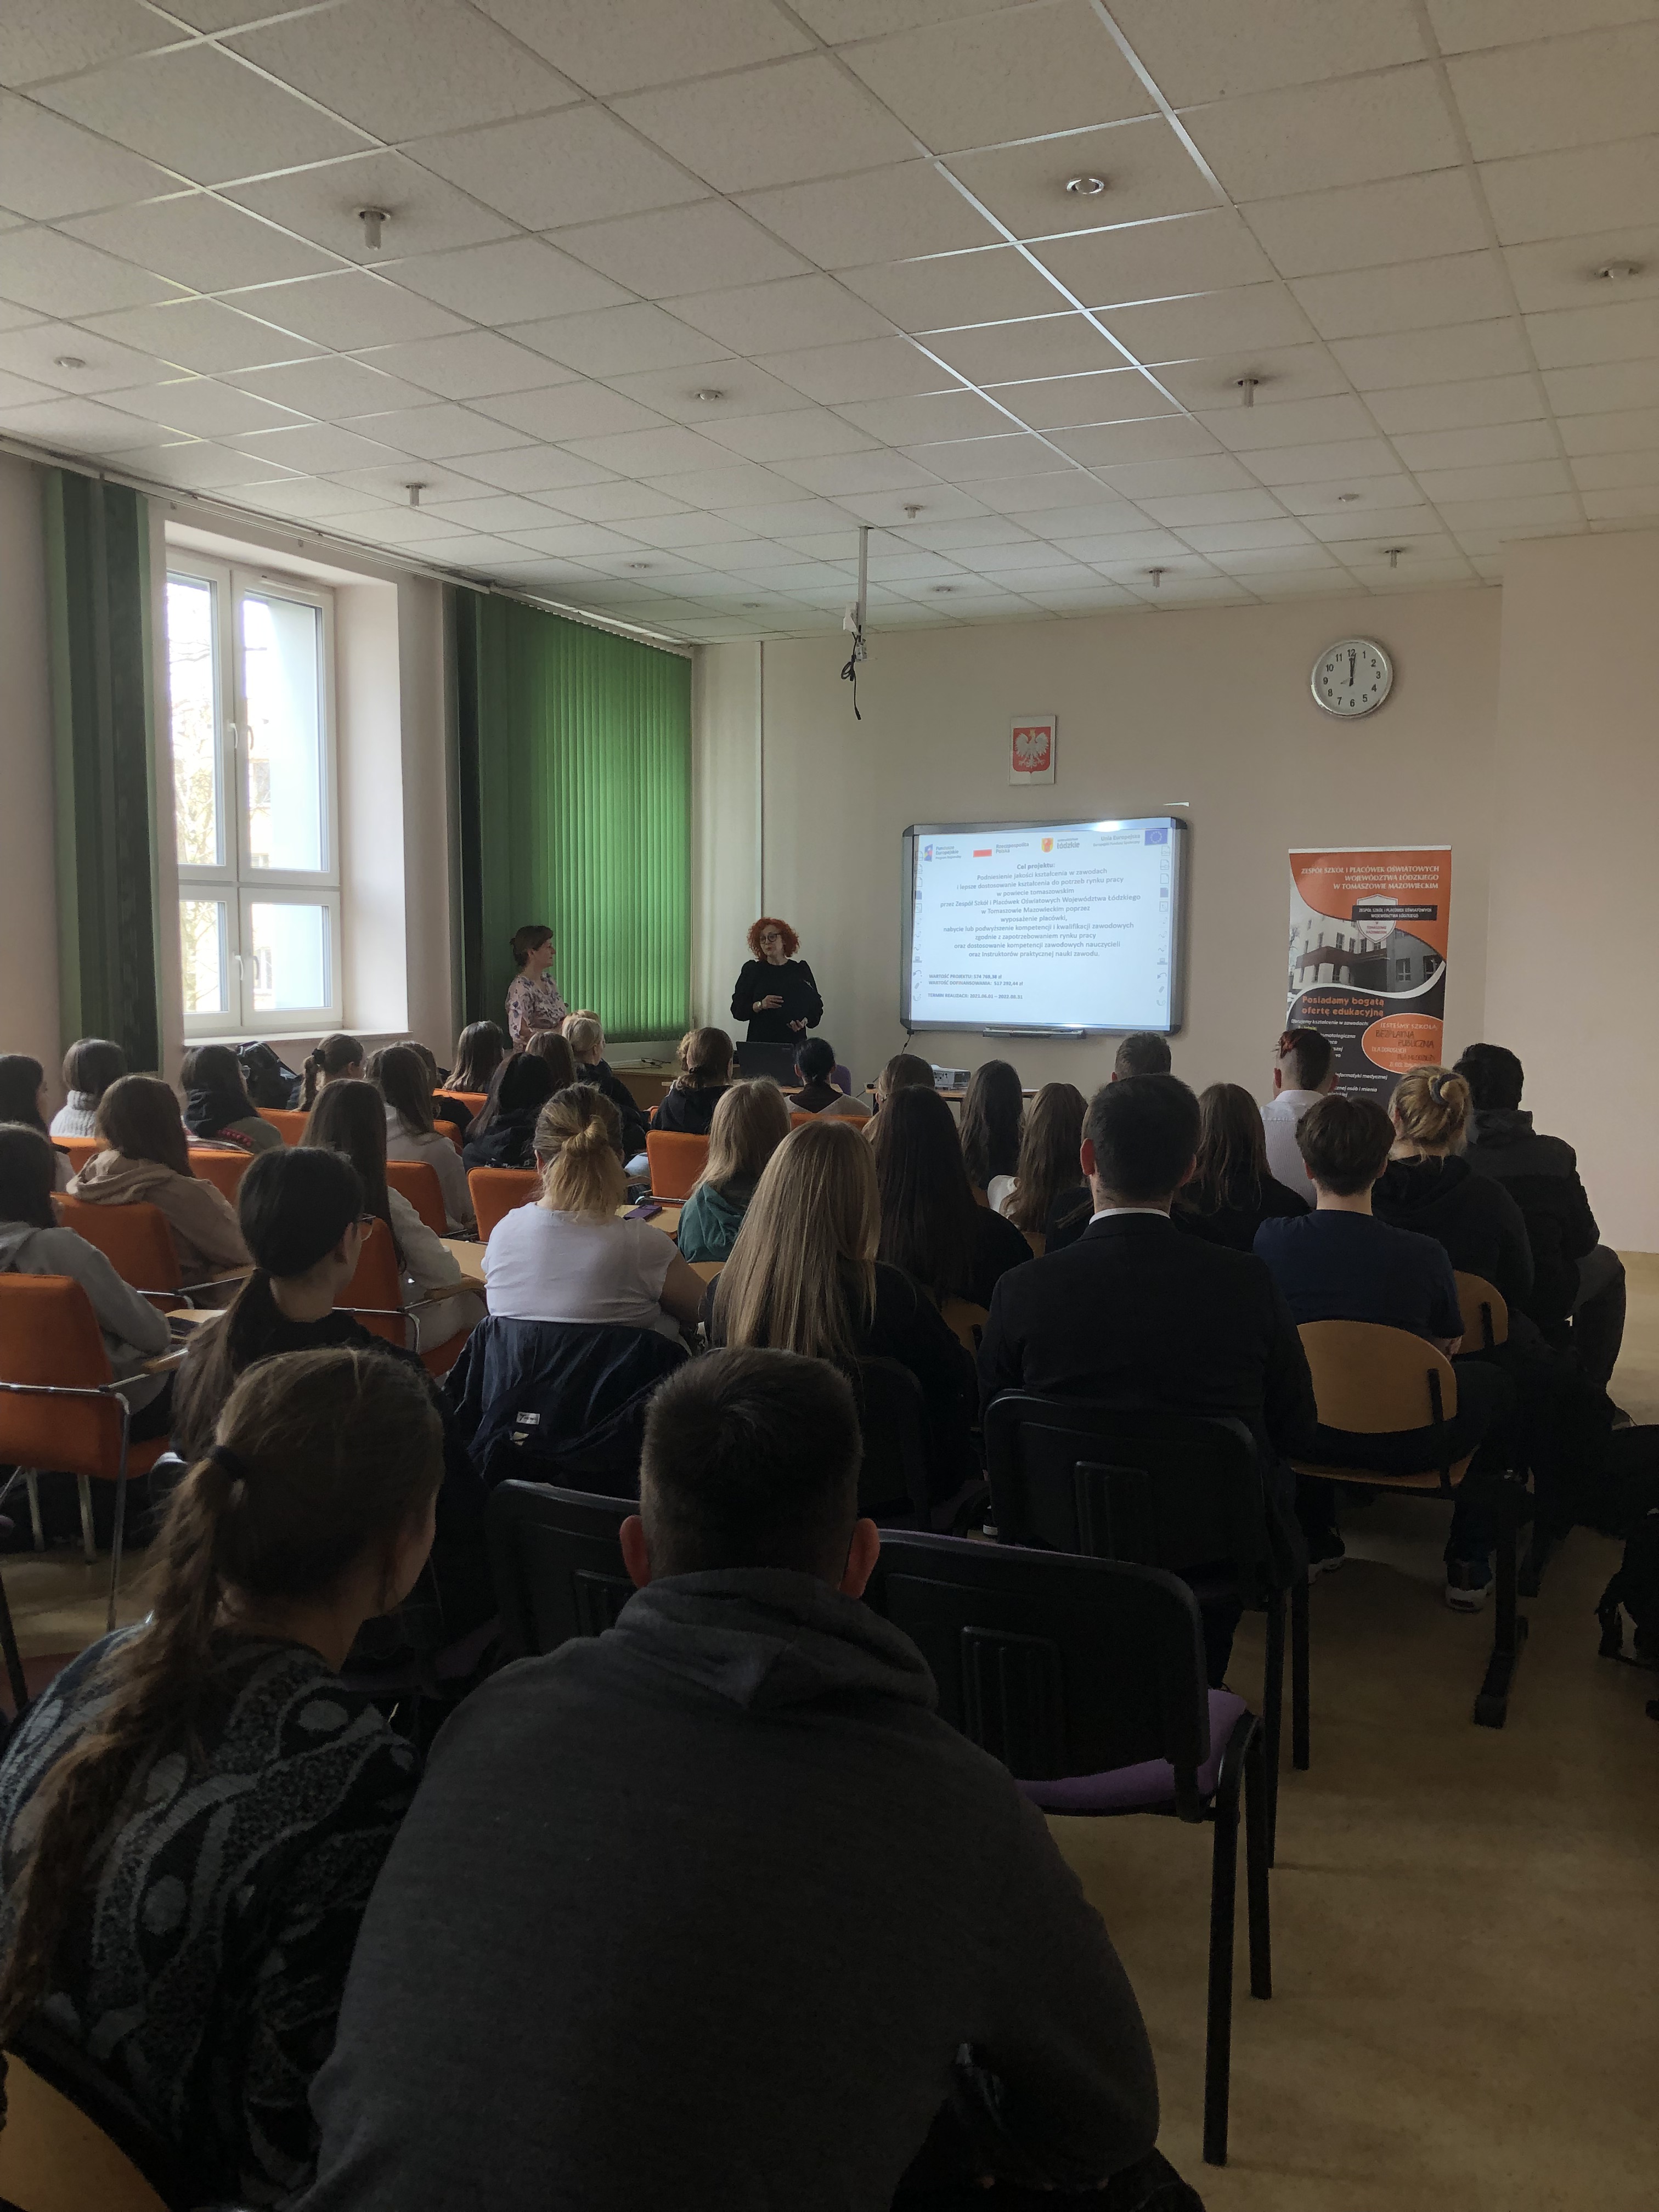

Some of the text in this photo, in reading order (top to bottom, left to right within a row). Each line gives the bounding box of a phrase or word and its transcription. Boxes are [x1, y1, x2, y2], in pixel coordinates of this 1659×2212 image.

[1347, 648, 1356, 657] 12
[1336, 653, 1342, 662] 11
[1371, 659, 1376, 667] 2
[1376, 671, 1381, 679] 3
[1328, 689, 1333, 697] 8
[1337, 697, 1342, 706] 7
[1362, 694, 1368, 702] 5
[1350, 865, 1385, 873] PLACÓWEK
[1345, 873, 1398, 882] WOJEWÓDZTWA
[1021, 896, 1060, 905] Oświatowych
[1062, 895, 1107, 904] Województwa
[1302, 996, 1384, 1007] Posiadamy bogatą
[1301, 1007, 1384, 1018] ofertę edukacyjną
